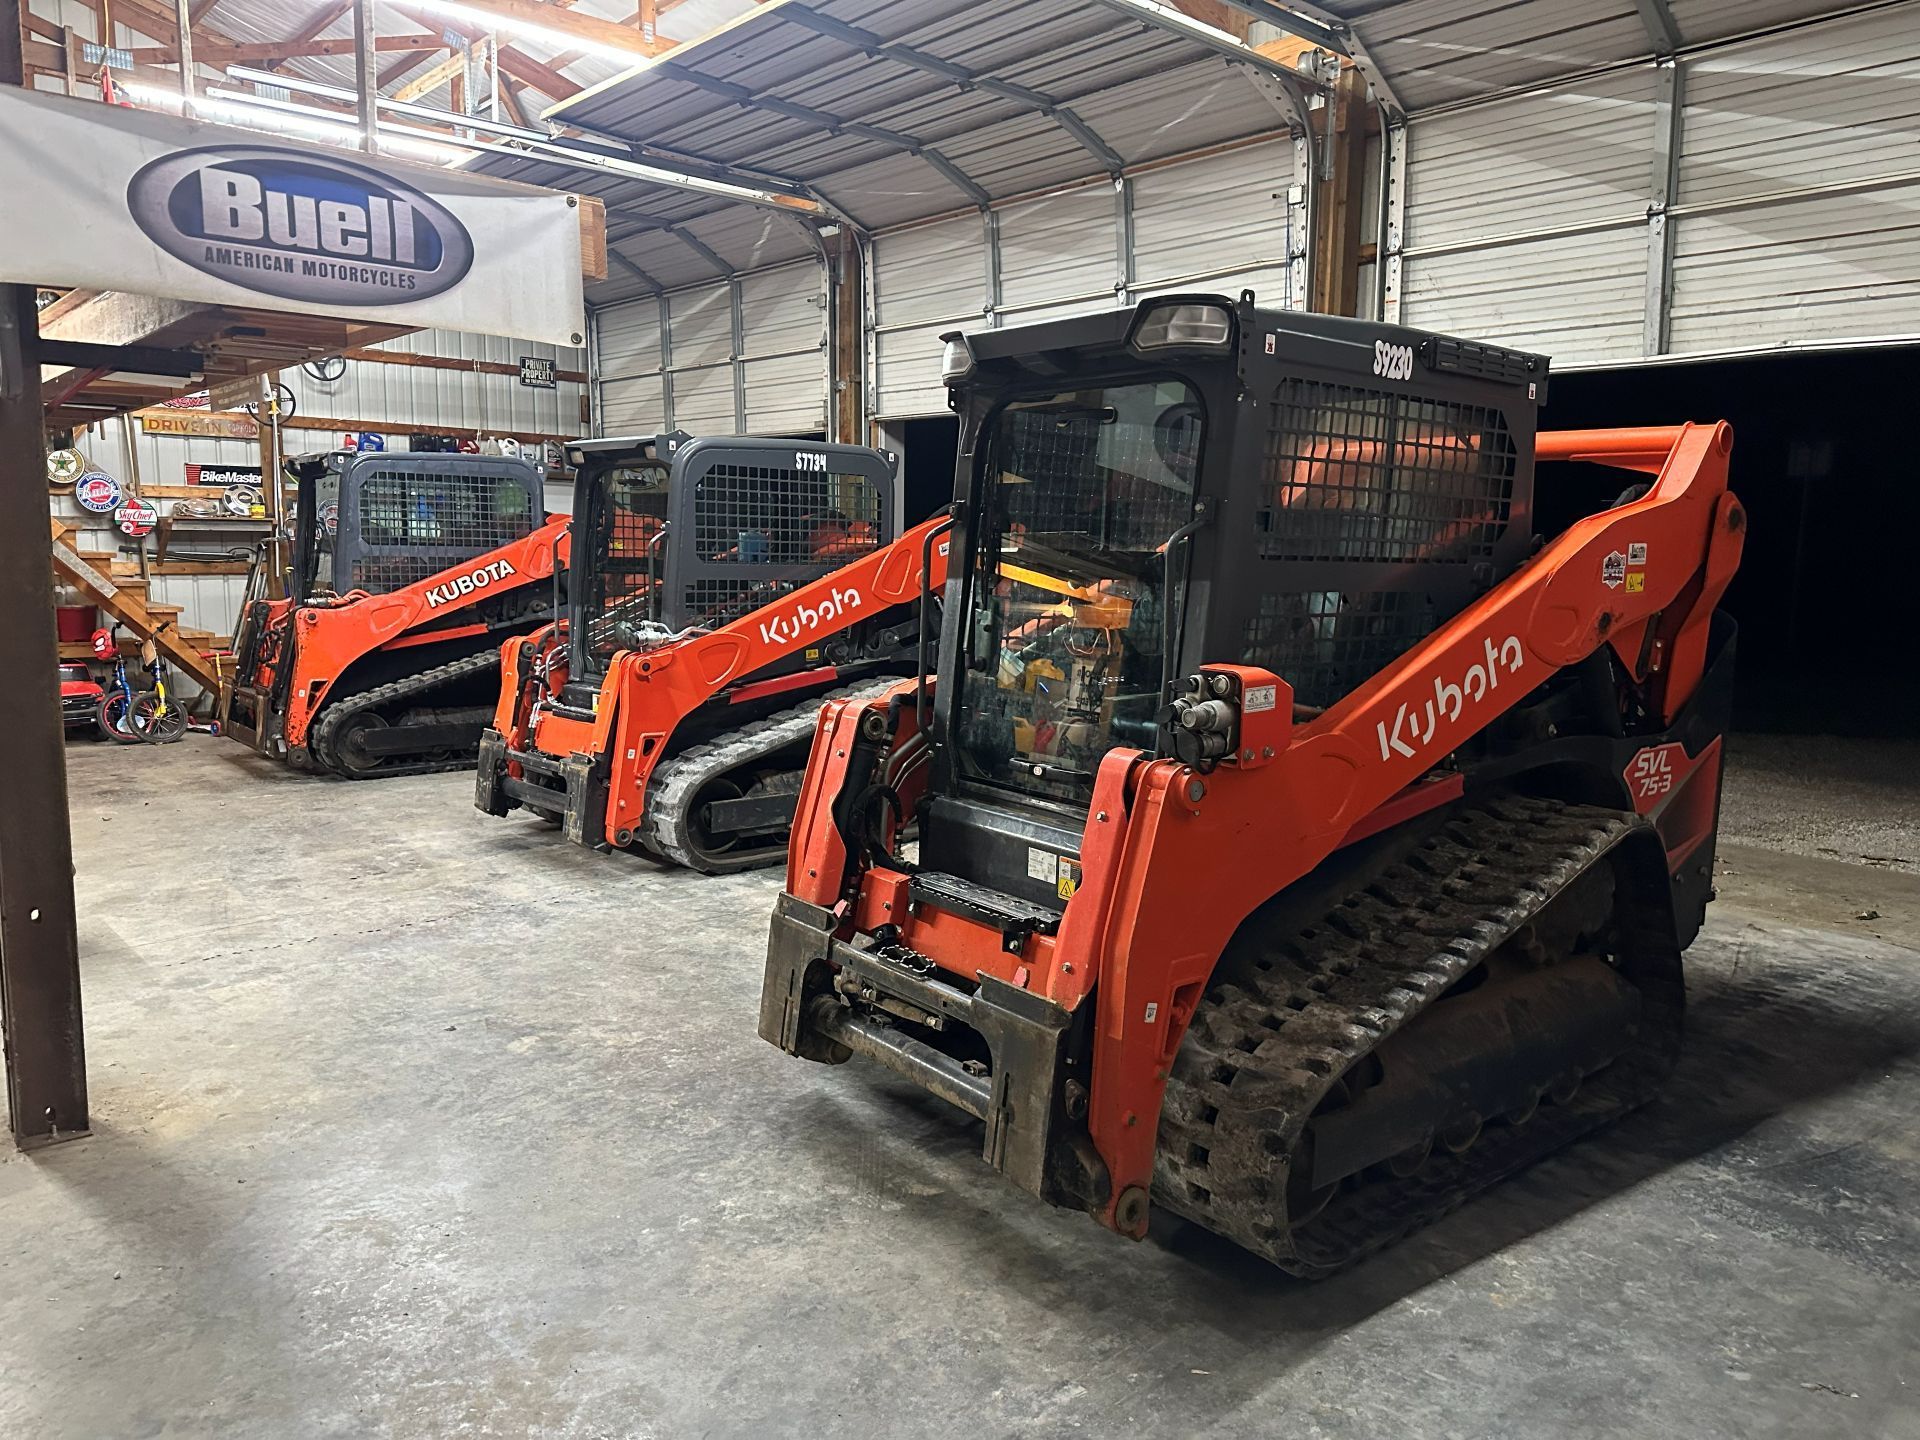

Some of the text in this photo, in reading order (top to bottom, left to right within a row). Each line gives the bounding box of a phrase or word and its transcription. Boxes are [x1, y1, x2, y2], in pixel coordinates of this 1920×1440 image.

[200, 167, 415, 264] Buell
[205, 246, 416, 290] AMERICAN MOTORCYCLES
[525, 359, 550, 371] PRIVATE
[1373, 339, 1413, 381] S9230
[148, 419, 201, 433] DRIVE
[200, 470, 263, 484] BikeMaster
[795, 452, 827, 472] S7734
[118, 509, 154, 523] Sky Chief
[425, 559, 517, 609] KUBOTA
[759, 587, 862, 645] Kubota
[1376, 635, 1524, 763] Kubota
[1634, 750, 1672, 778] SVL
